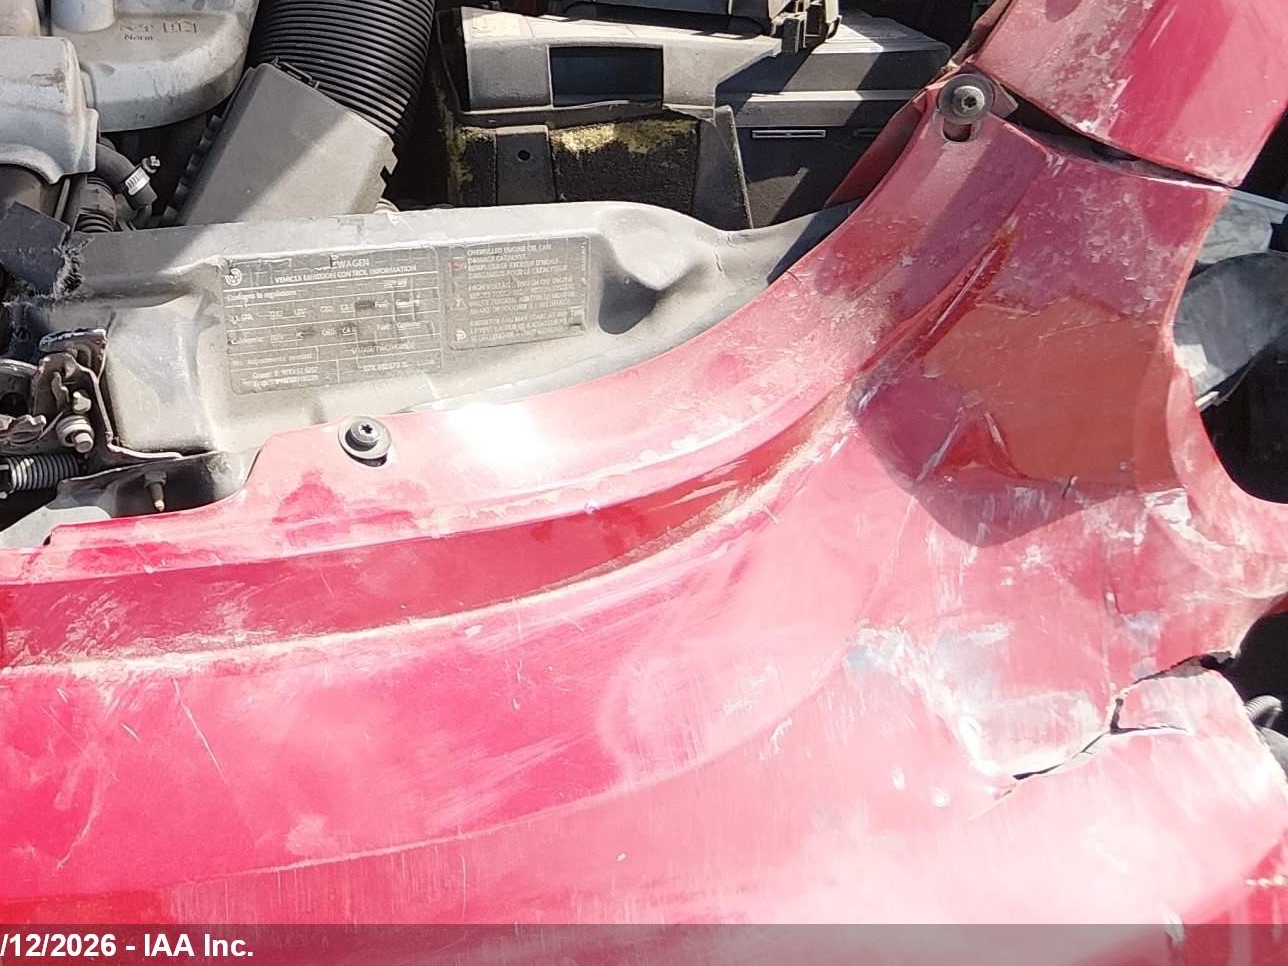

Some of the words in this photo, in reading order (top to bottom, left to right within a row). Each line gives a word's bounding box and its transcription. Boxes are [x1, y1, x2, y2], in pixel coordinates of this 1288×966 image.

[274, 275, 302, 284] VEHICLE
[337, 268, 369, 278] CONTROL
[368, 265, 417, 276] INFORMATION
